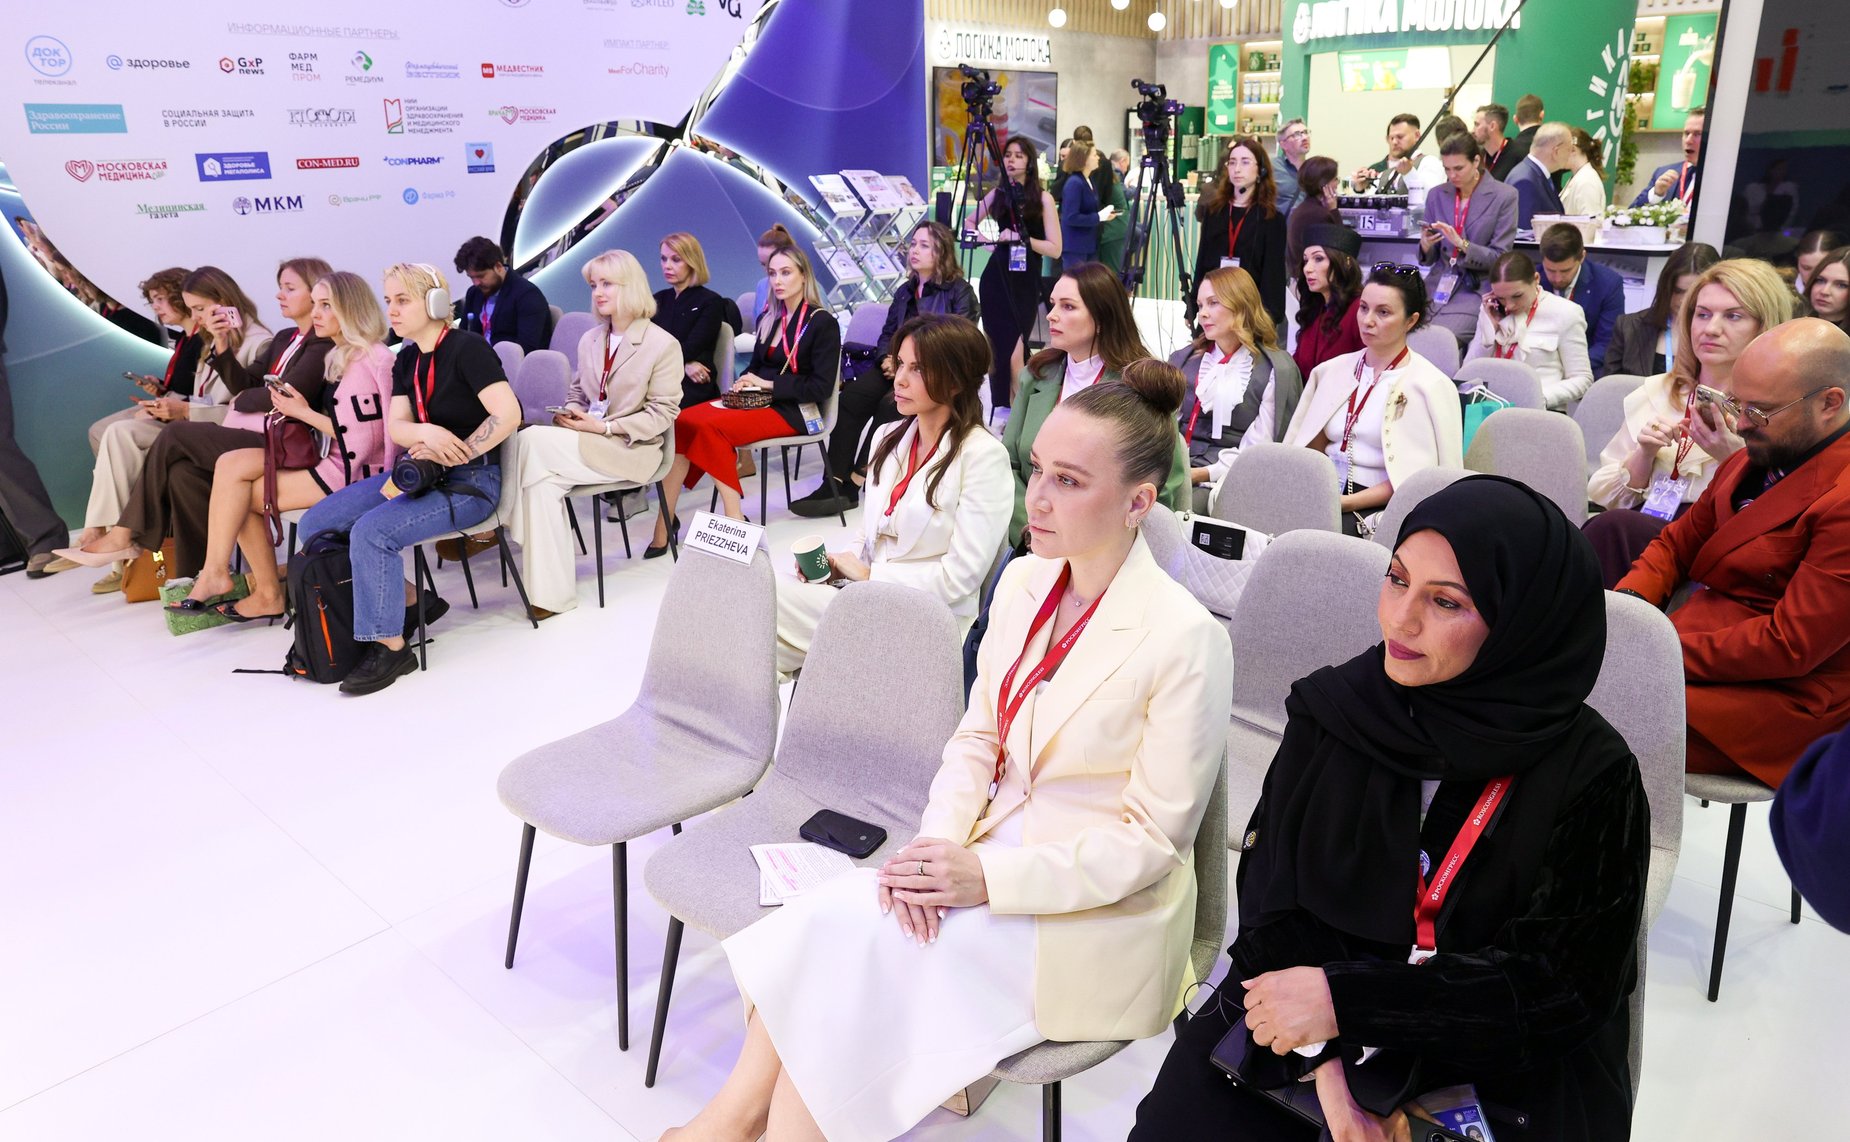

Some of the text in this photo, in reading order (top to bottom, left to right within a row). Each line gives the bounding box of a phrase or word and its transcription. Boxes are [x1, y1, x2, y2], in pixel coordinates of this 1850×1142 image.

[227, 22, 341, 37] ИНФОРМАЦИОННЫЕ
[32, 47, 61, 58] ДОК
[955, 32, 1051, 63] ЛОГИКА МОЛОКА
[40, 57, 66, 67] ТОР
[288, 52, 318, 61] ФАРМ
[126, 58, 190, 70] здоровье
[238, 57, 263, 68] GxP
[291, 62, 313, 72] МЕД
[496, 65, 544, 73] МЕДВЕСТНИК
[292, 73, 321, 81] ПРОМ
[345, 75, 384, 83] РЕМЕДИУМ
[28, 110, 121, 122] Здравоохранение
[161, 109, 255, 119] СОЦИАЛЬНАЯ ЗАЩИТА
[31, 121, 70, 131] России
[164, 119, 207, 128] В РОССИИ
[96, 161, 168, 172] МОСКОВСКАЯ
[297, 158, 359, 169] CON-MED.RU
[388, 157, 441, 166] CONPHARM
[98, 171, 152, 182] МЕДИЦИНА
[137, 202, 205, 214] Медицинская
[1362, 215, 1375, 230] 15
[708, 518, 747, 539] Ekaterina
[695, 530, 748, 556] PRIEZZHEVA
[1476, 782, 1502, 821] ROSCONGRESS
[1435, 852, 1460, 894] РОСКОНГРЕСС
